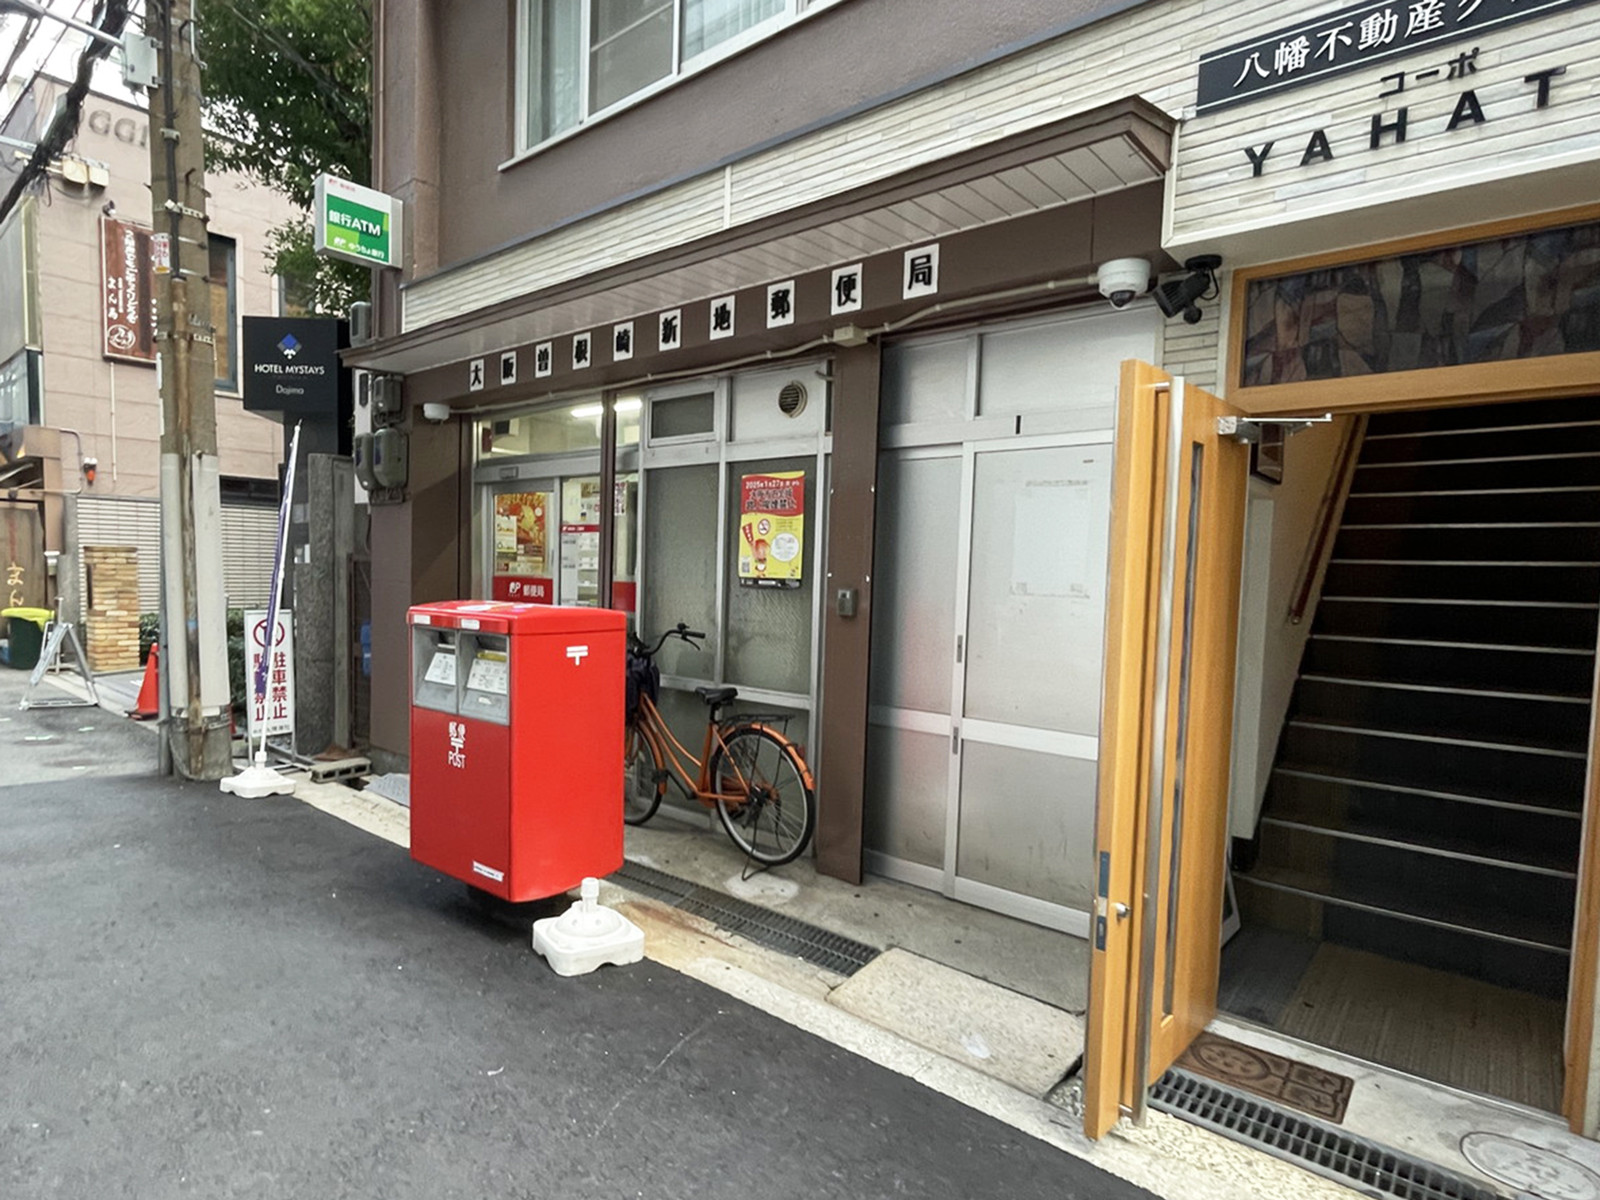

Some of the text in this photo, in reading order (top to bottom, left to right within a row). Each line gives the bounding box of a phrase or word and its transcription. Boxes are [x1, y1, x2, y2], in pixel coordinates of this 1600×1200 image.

[1379, 47, 1480, 99] コーポ
[328, 209, 382, 237] 銀行ATM
[254, 363, 325, 375] HOTEL MYSTAYS
[275, 384, 305, 396] Dojima
[448, 750, 466, 769] POST
